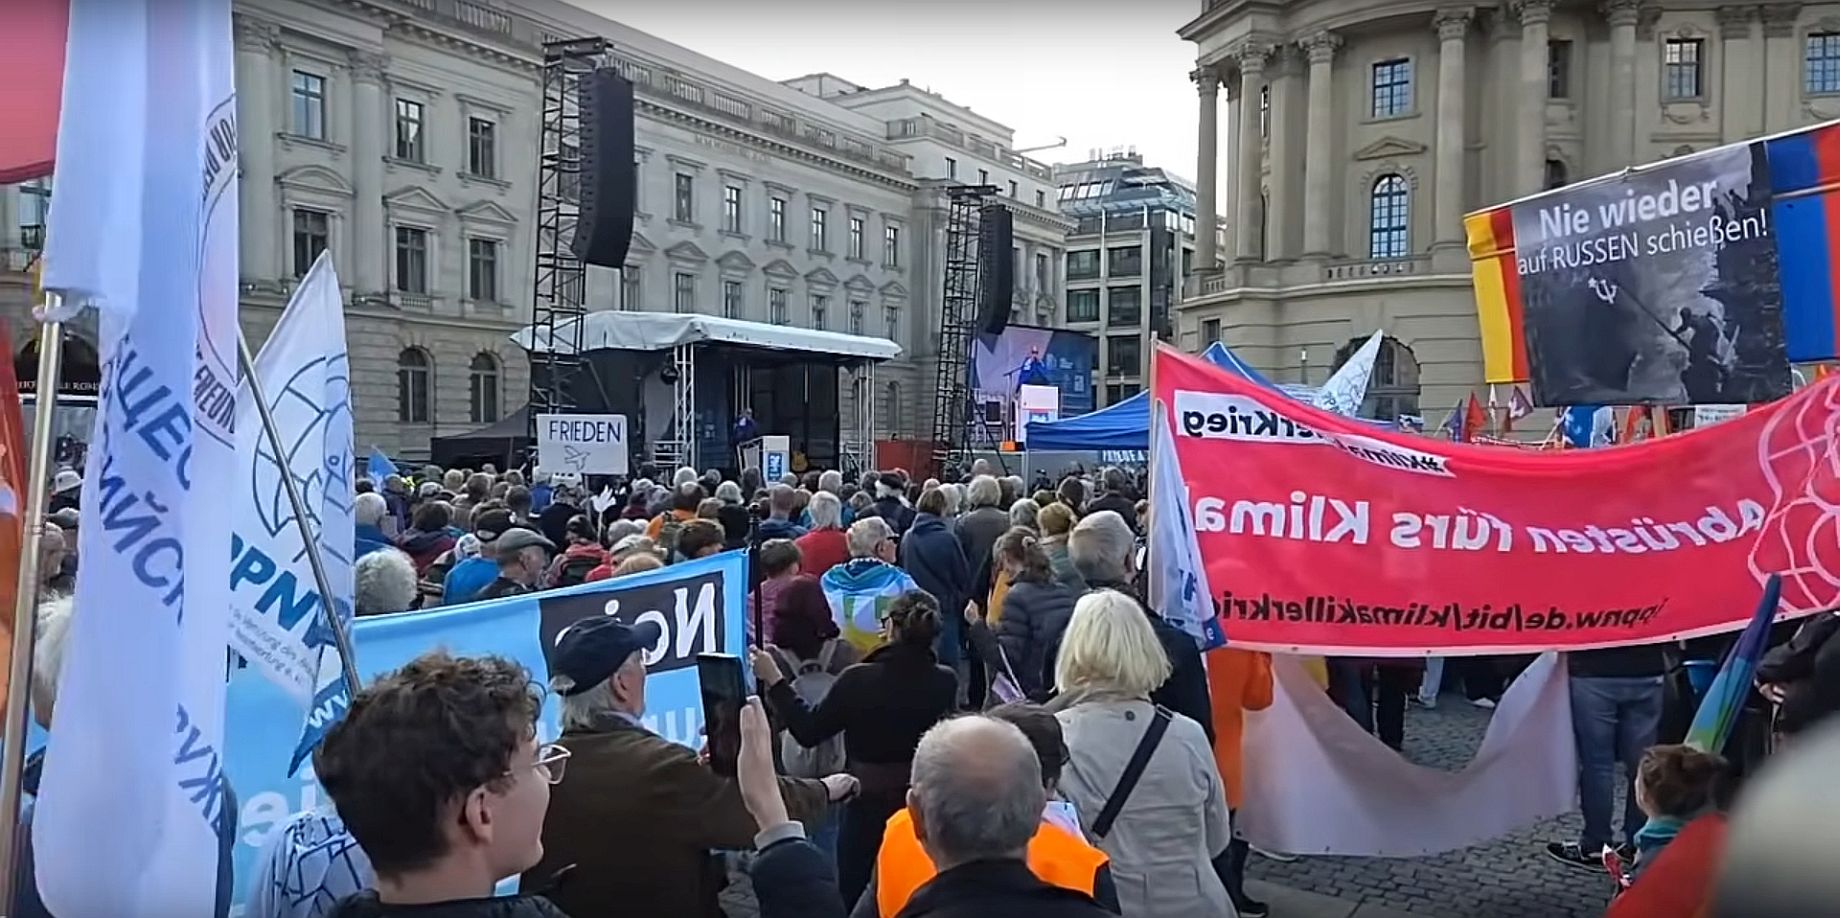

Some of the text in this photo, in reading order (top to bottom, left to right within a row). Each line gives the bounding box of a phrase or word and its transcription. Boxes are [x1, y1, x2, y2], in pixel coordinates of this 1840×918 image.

[1540, 179, 1719, 240] Nie wieder
[1517, 207, 1768, 275] auf RUSSEN schießen!
[549, 420, 621, 443] FRIEDEN
